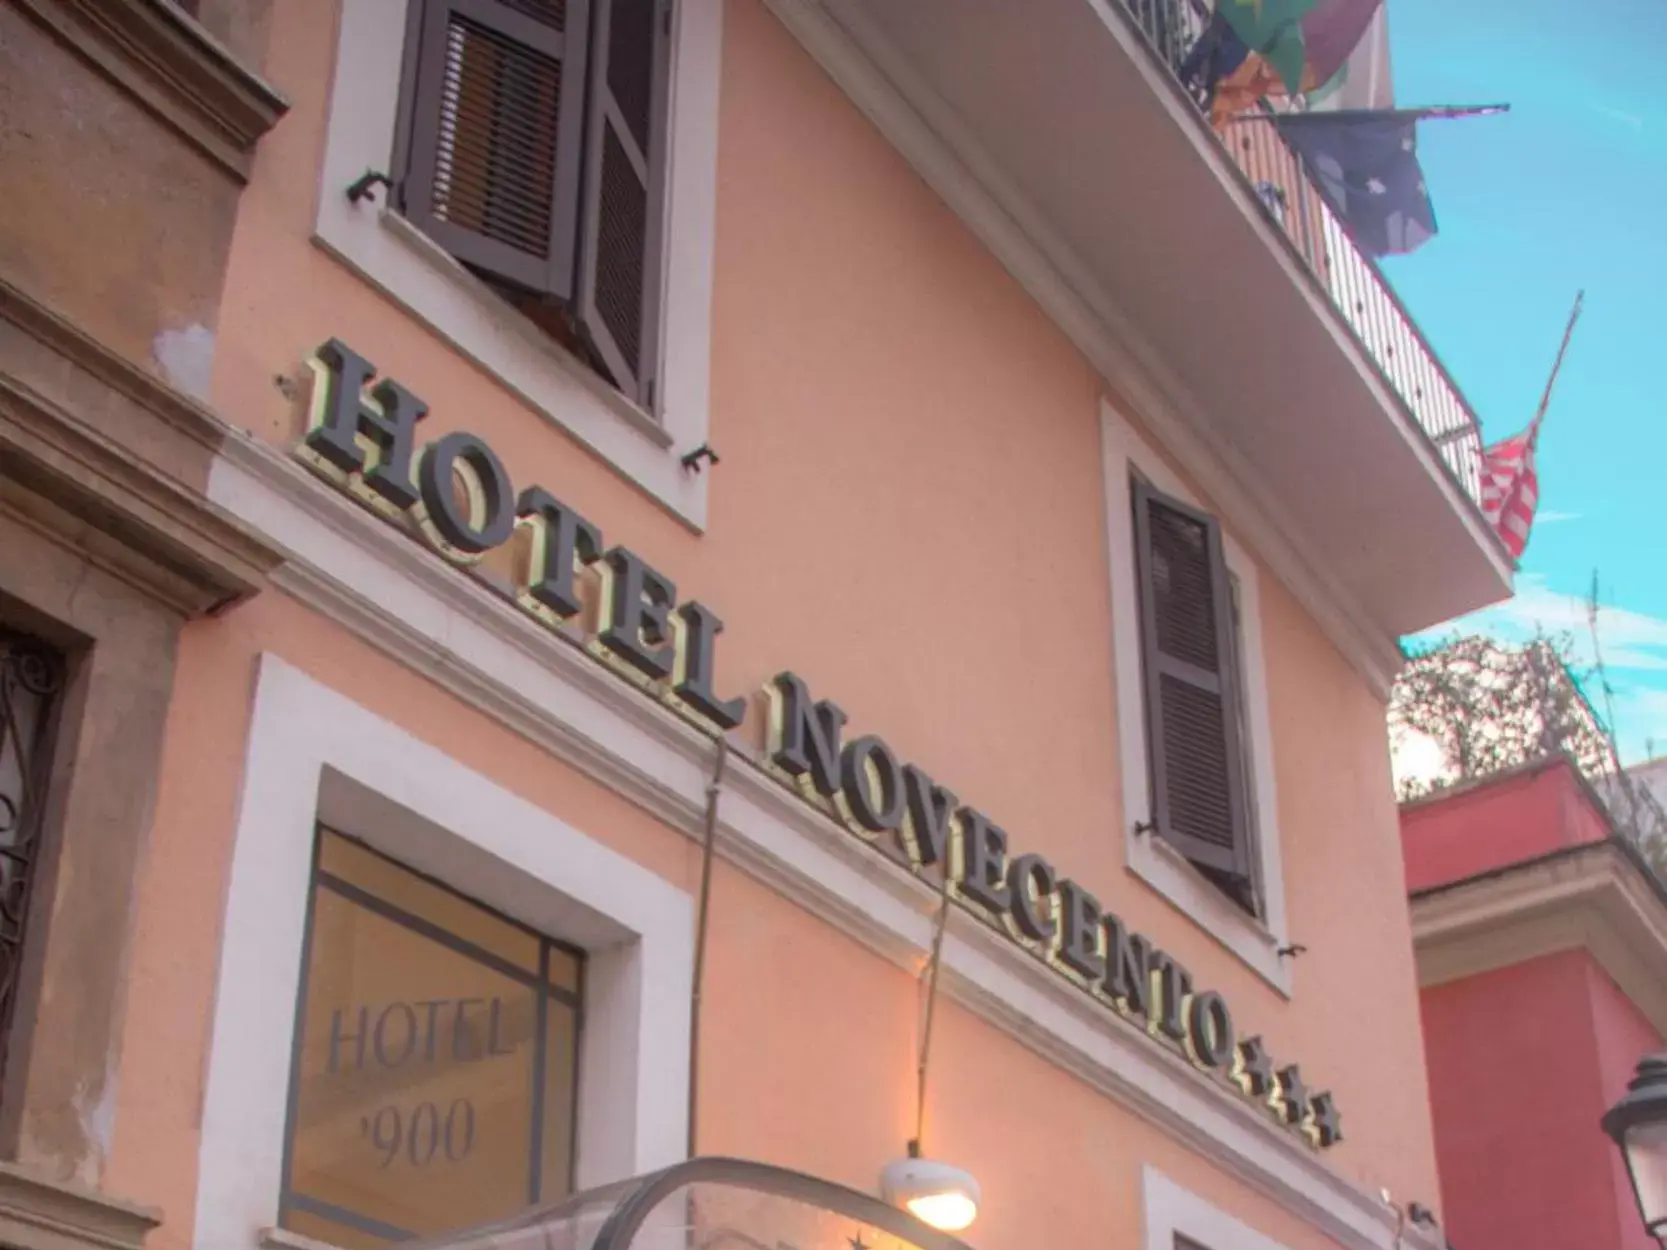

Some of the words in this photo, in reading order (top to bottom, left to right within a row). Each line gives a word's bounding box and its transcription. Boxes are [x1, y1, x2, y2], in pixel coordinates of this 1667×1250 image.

[307, 336, 747, 730] HOTEL
[767, 670, 1233, 1068] NOVECENTO
[328, 996, 517, 1074] HOTEL
